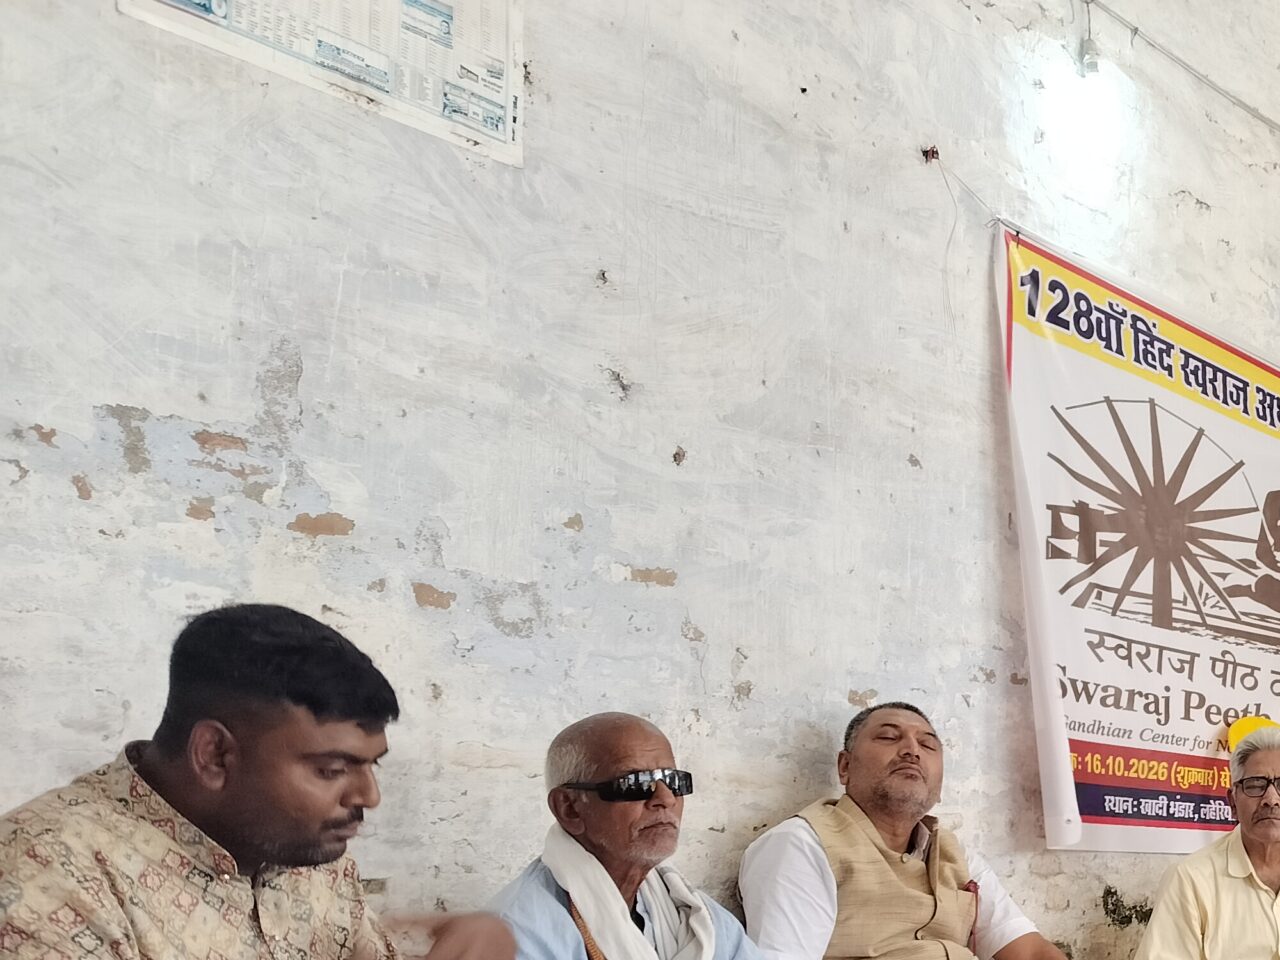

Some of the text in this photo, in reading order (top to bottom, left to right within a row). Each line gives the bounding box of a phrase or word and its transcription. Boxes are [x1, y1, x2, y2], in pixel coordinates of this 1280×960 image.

[1130, 314, 1175, 379] हिंद
[1179, 347, 1249, 416] स्वराज
[1084, 628, 1201, 683] स्वराज
[1209, 649, 1262, 692] पीठ
[1139, 727, 1190, 748] Center
[1190, 735, 1213, 752] for
[1084, 752, 1169, 781] 16.10.2026
[1170, 761, 1219, 790] (शुक्रवार)
[1104, 795, 1139, 814] स्थान:
[1139, 796, 1169, 817] खादी
[1169, 794, 1199, 821] भंडार,
